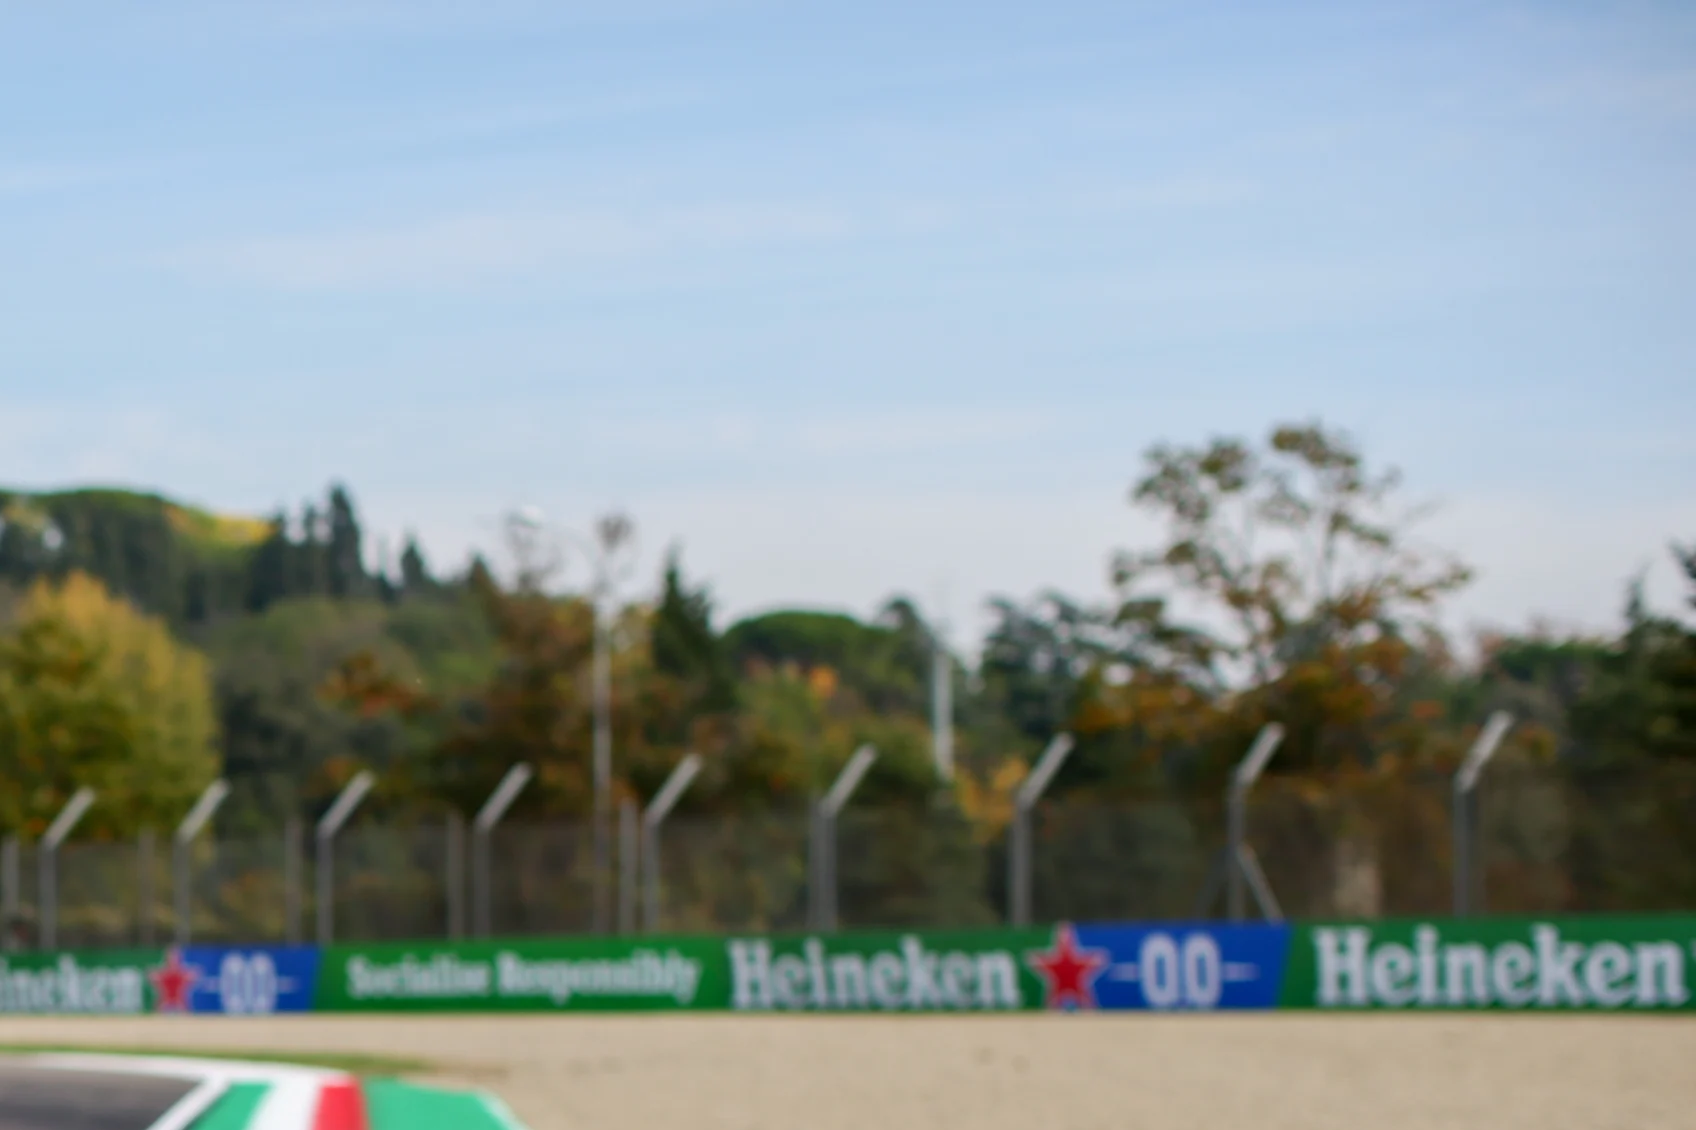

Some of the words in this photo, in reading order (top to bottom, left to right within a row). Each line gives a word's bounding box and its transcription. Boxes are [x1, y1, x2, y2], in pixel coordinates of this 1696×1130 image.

[497, 951, 701, 1003] Responsibly
[728, 937, 1022, 1010] Heineken
[1313, 925, 1687, 1009] Heineken
